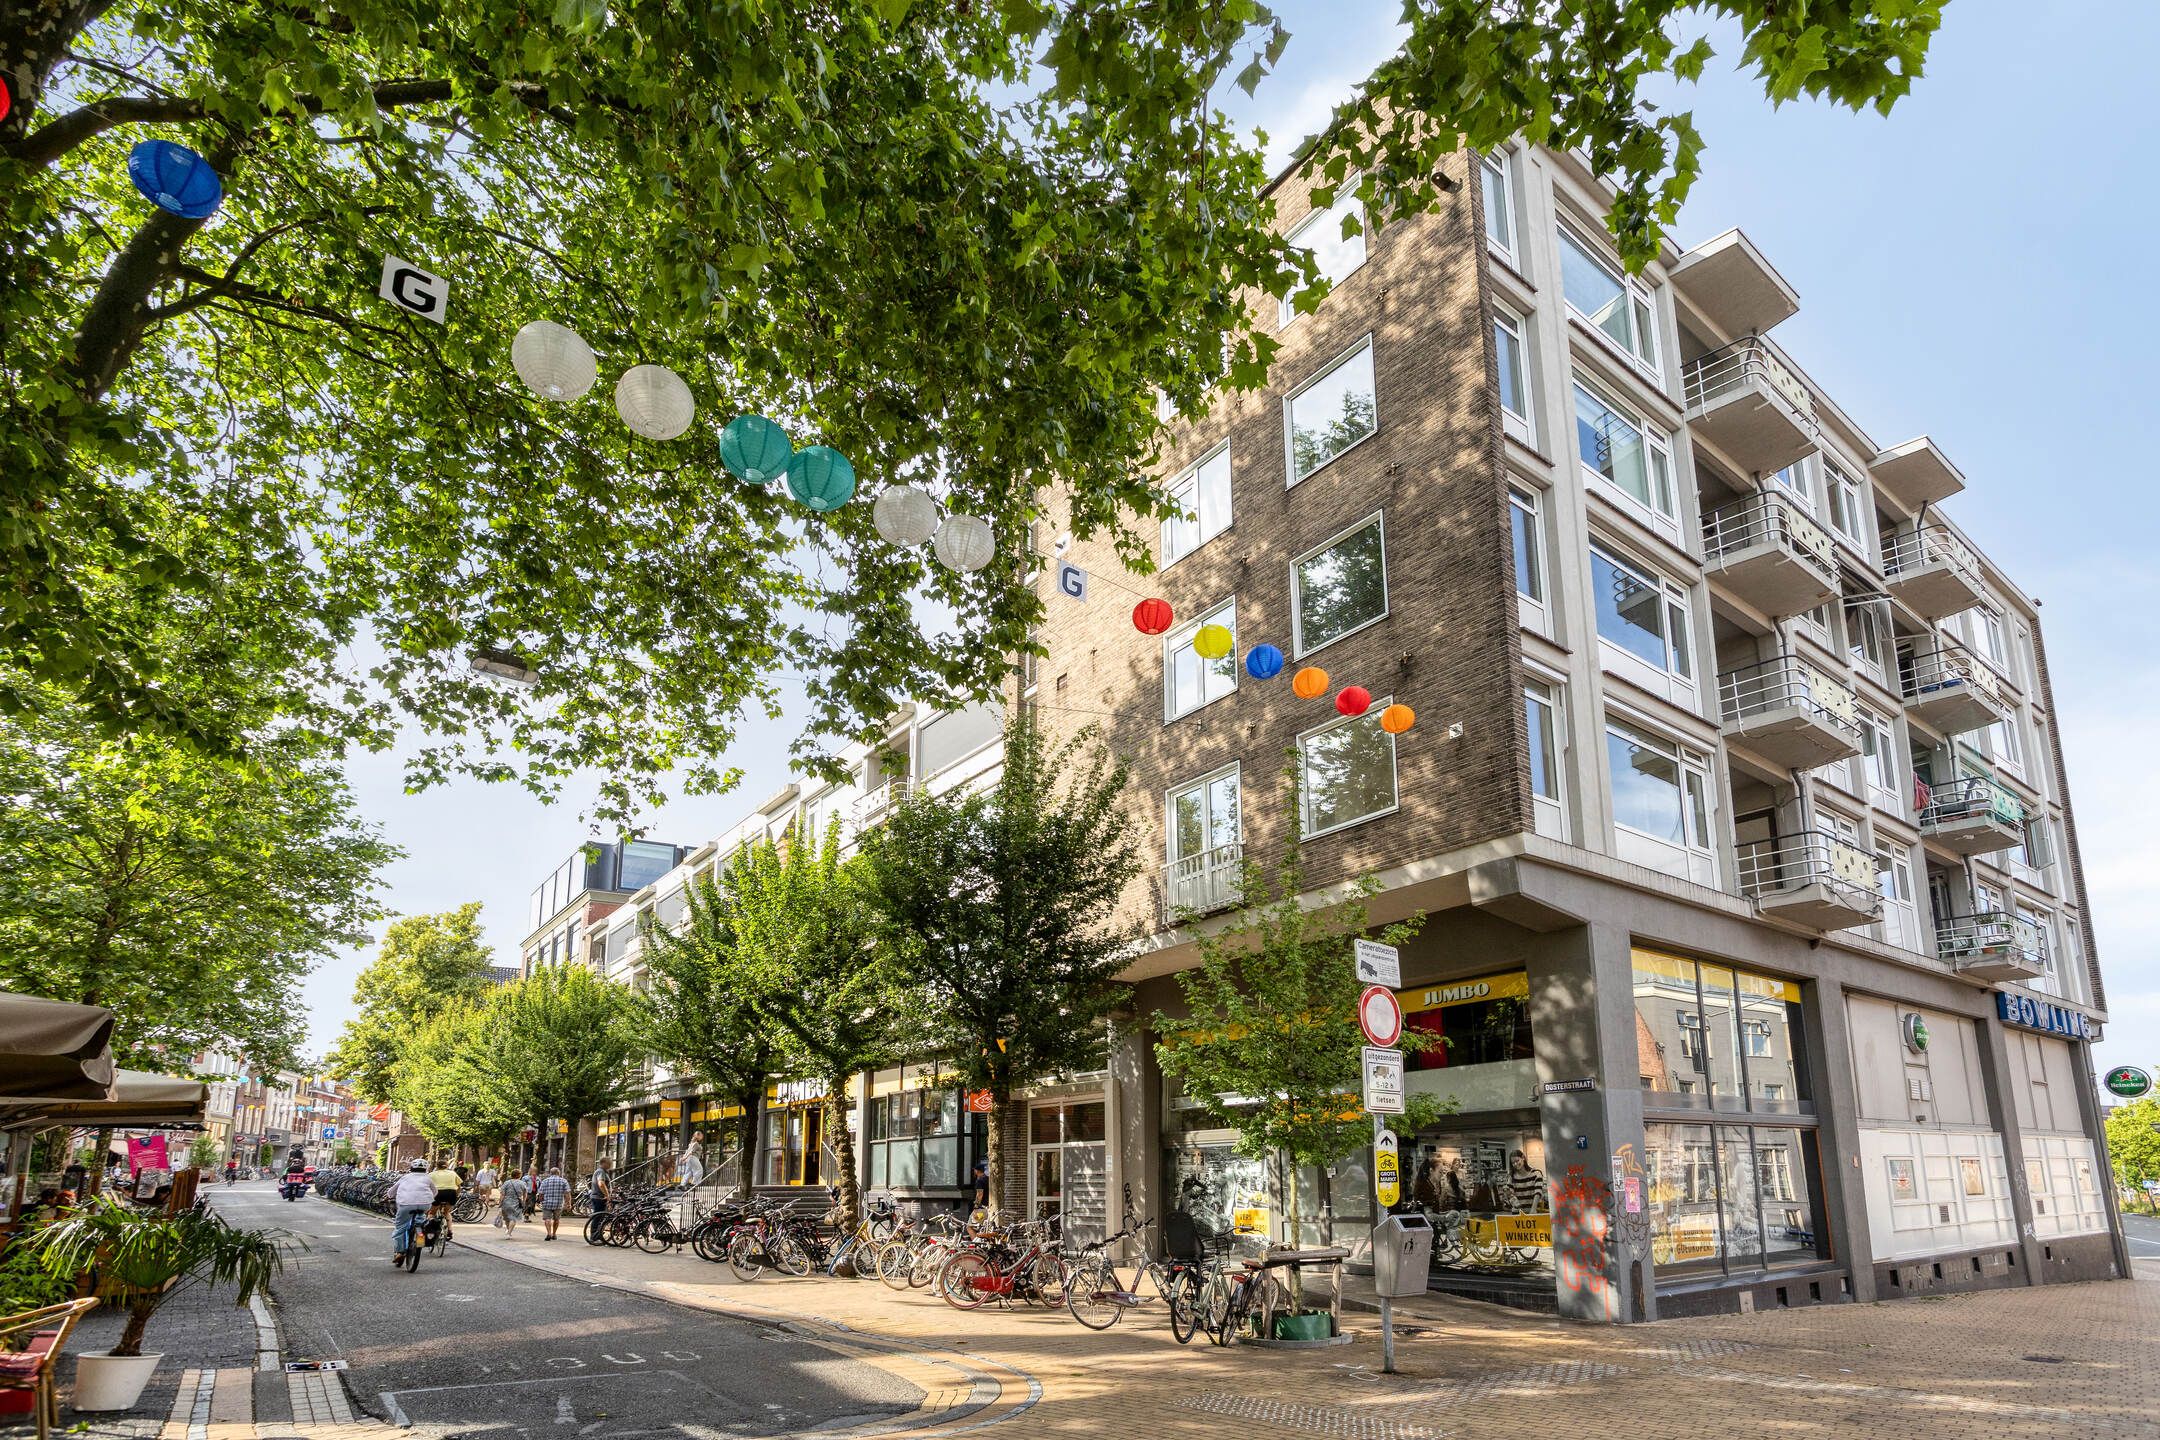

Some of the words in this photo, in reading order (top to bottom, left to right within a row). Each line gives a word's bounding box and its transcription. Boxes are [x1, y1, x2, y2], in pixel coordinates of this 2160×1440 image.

[391, 268, 437, 313] G
[1062, 566, 1083, 597] G
[1424, 982, 1490, 1006] JUMBO
[2004, 991, 2092, 1039] BOWLING
[1368, 1053, 1400, 1063] uitgezonderd
[775, 1078, 829, 1104] JUMBO
[1545, 1080, 1590, 1091] OOSTERSTRAAT
[1376, 1096, 1396, 1104] fietsen
[1515, 1219, 1537, 1229] VLOT
[1505, 1231, 1551, 1242] WINKELEN
